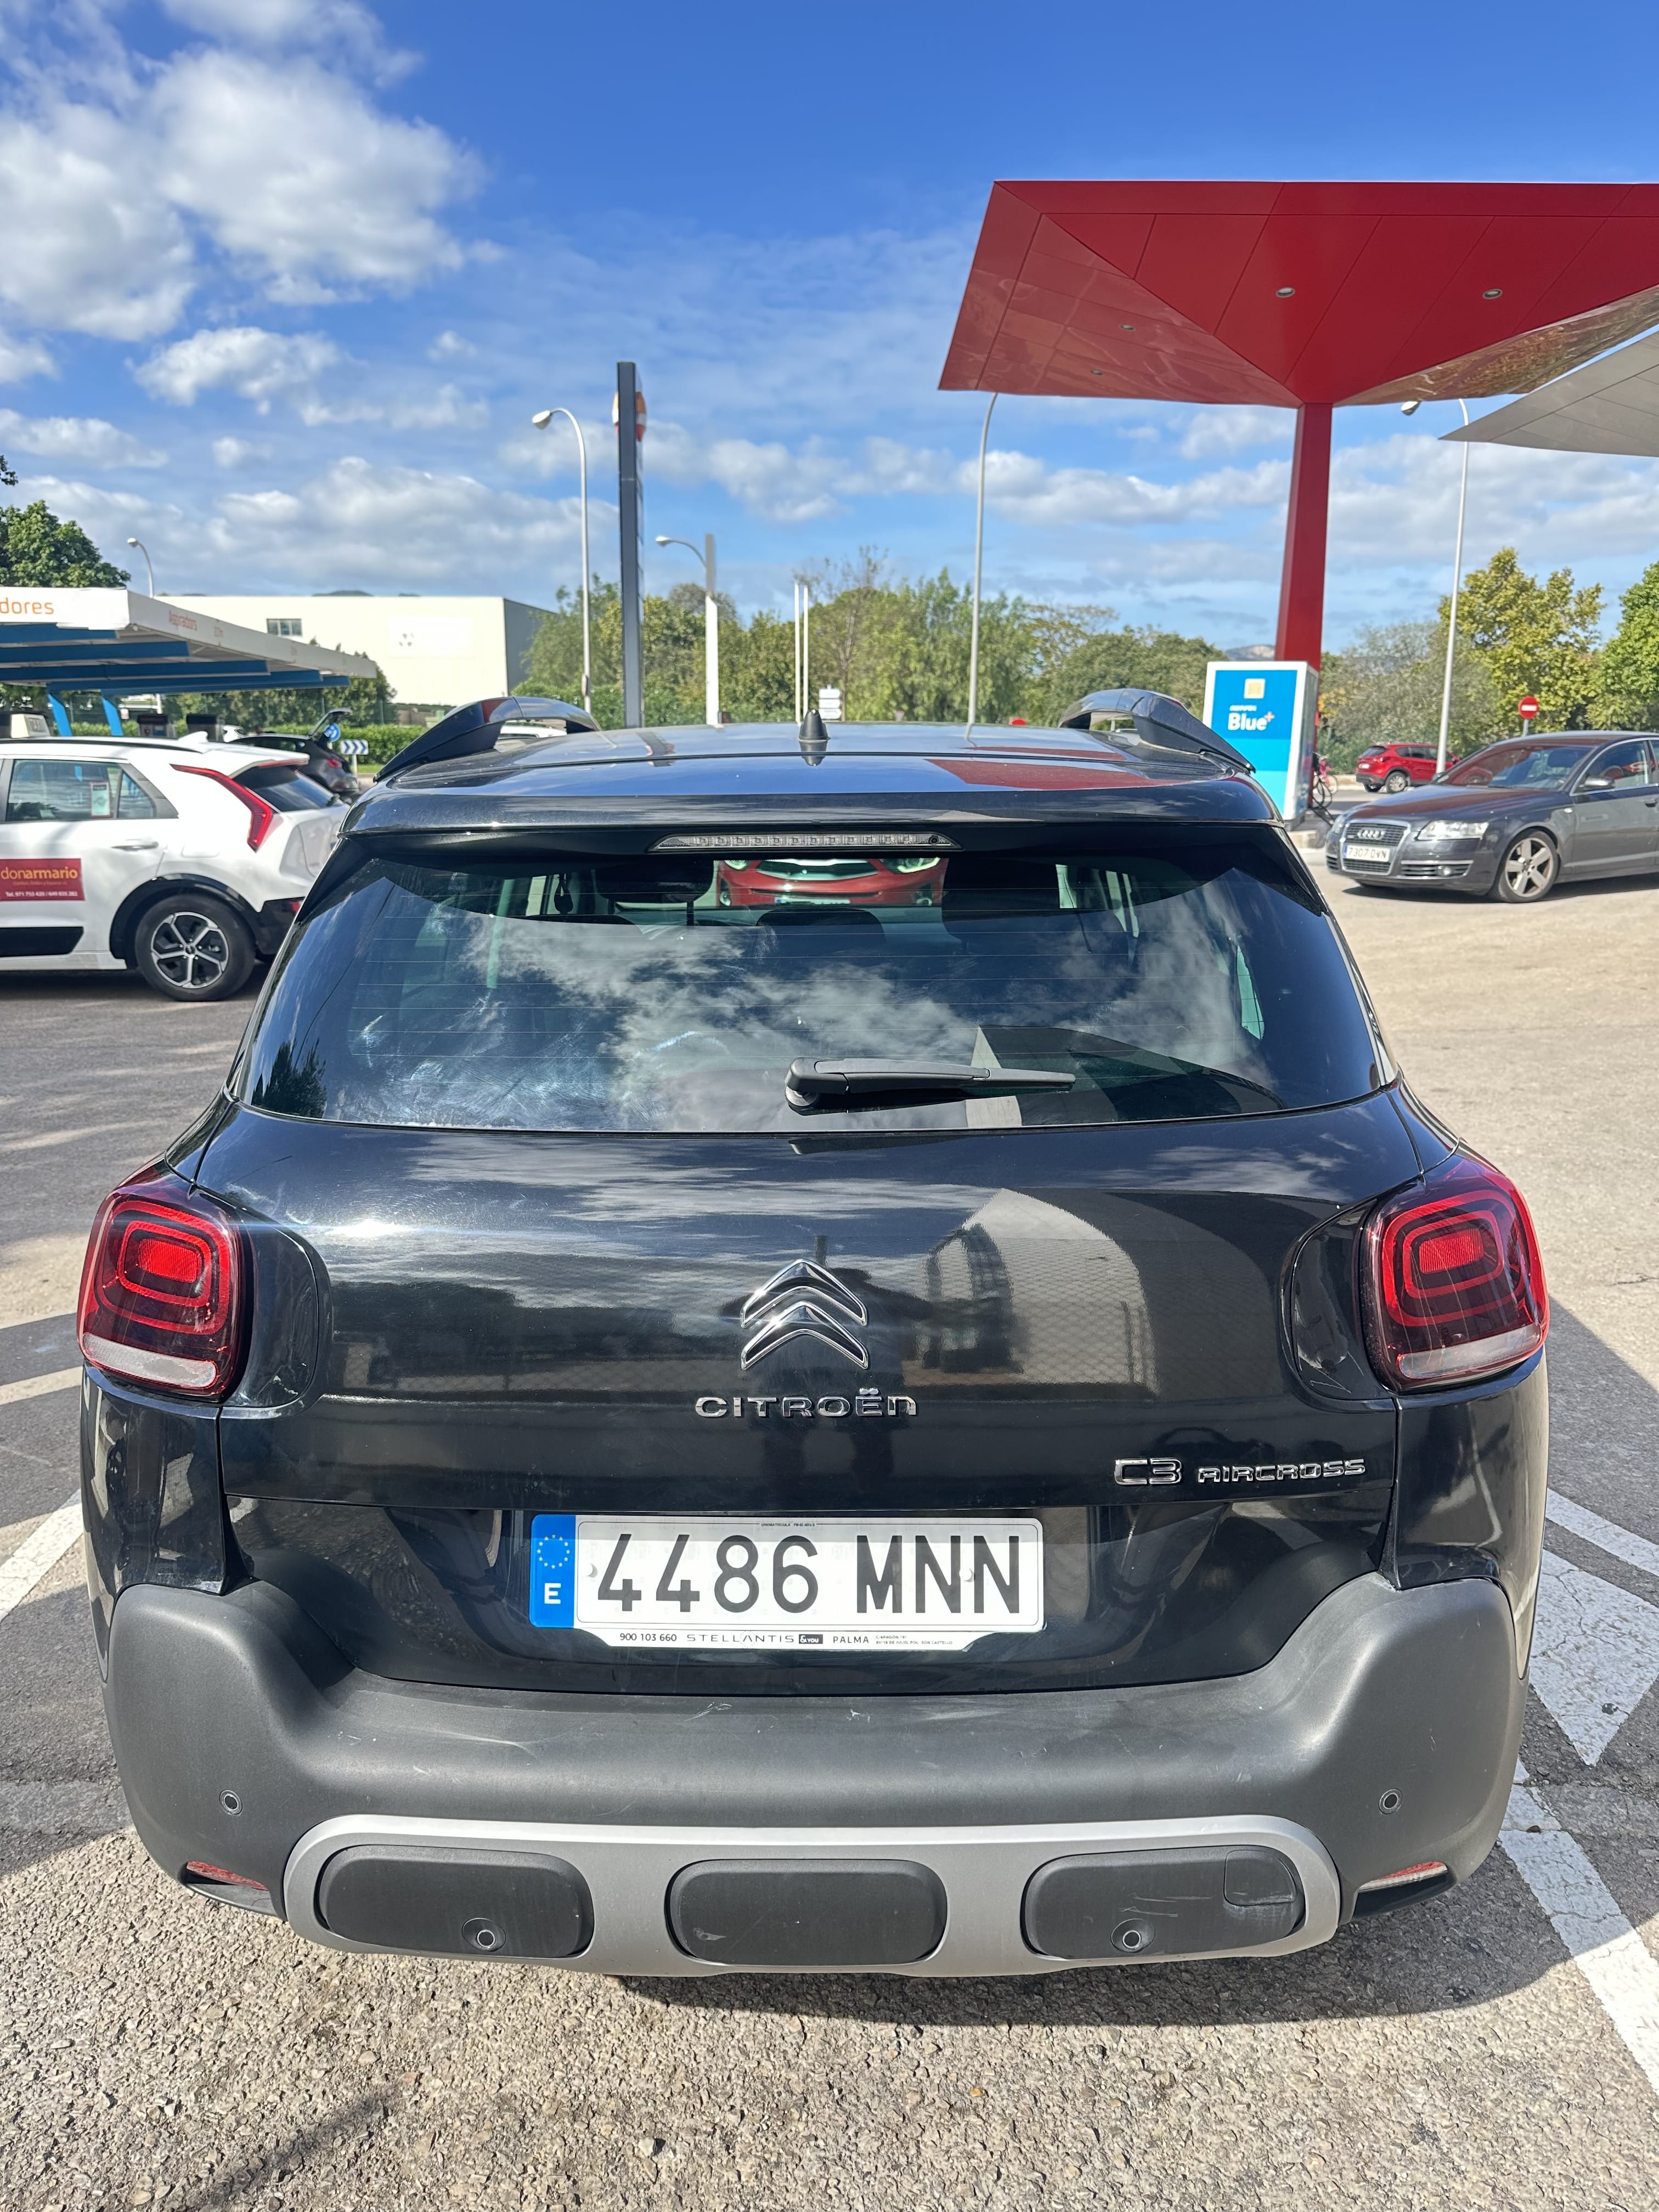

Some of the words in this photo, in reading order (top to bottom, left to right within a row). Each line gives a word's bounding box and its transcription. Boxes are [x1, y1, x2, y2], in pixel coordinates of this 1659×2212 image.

[0, 597, 54, 614] dores
[1348, 847, 1369, 857] 7307
[1370, 849, 1387, 859] DVN
[1, 866, 78, 879] donarmario
[1114, 1458, 1182, 1485] C3
[1197, 1458, 1366, 1483] AIRCROSS
[598, 1534, 819, 1613] 4486
[857, 1535, 1019, 1613] MNN
[544, 1583, 561, 1604] E
[620, 1633, 637, 1641] 900
[640, 1633, 657, 1641] 103
[659, 1633, 678, 1641] 660
[687, 1634, 794, 1643] STELLANTIS
